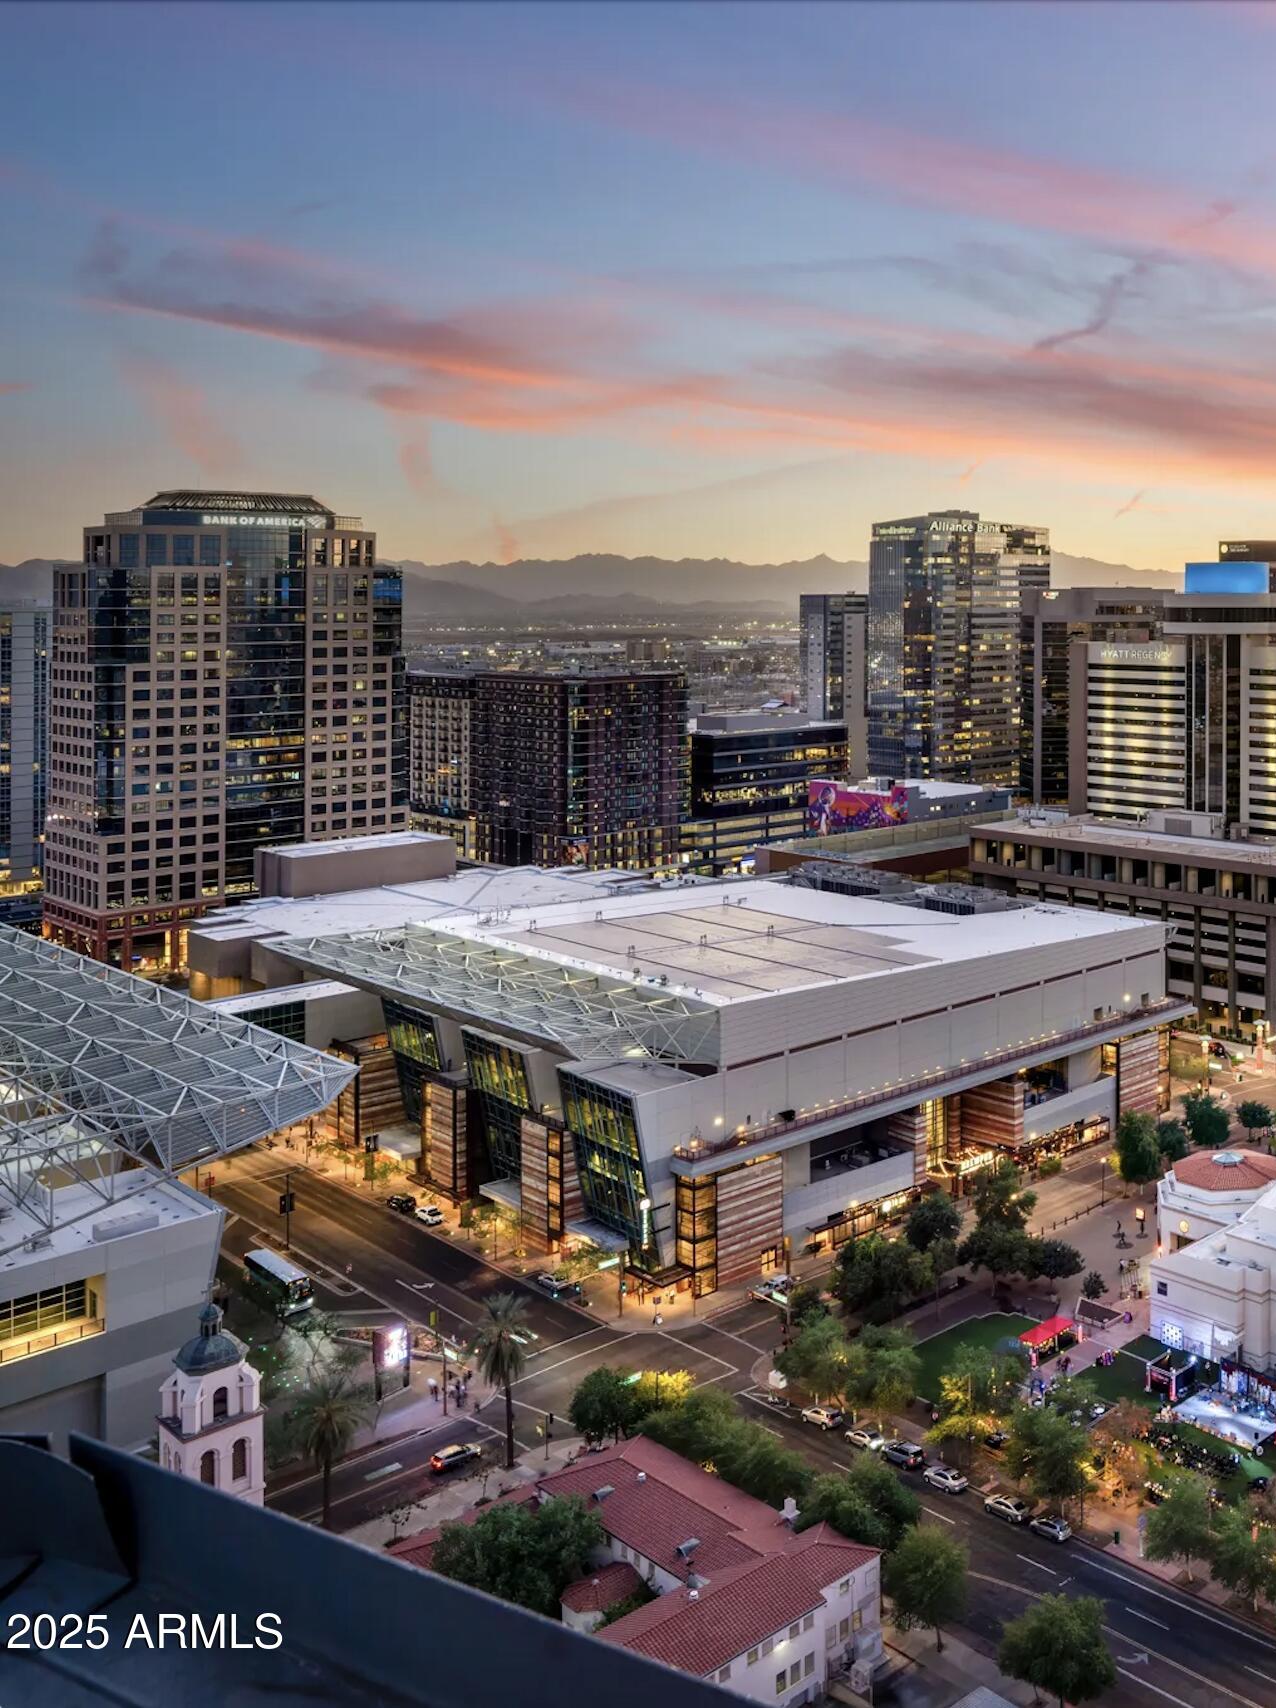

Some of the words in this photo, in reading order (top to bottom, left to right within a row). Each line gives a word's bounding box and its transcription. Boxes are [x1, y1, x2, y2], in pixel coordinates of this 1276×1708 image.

[202, 515, 238, 525] BANK
[239, 516, 256, 525] OF
[256, 516, 306, 527] AMERICA
[929, 520, 974, 532] Alliance
[977, 523, 1000, 533] Bank
[1100, 649, 1129, 659] HYATT
